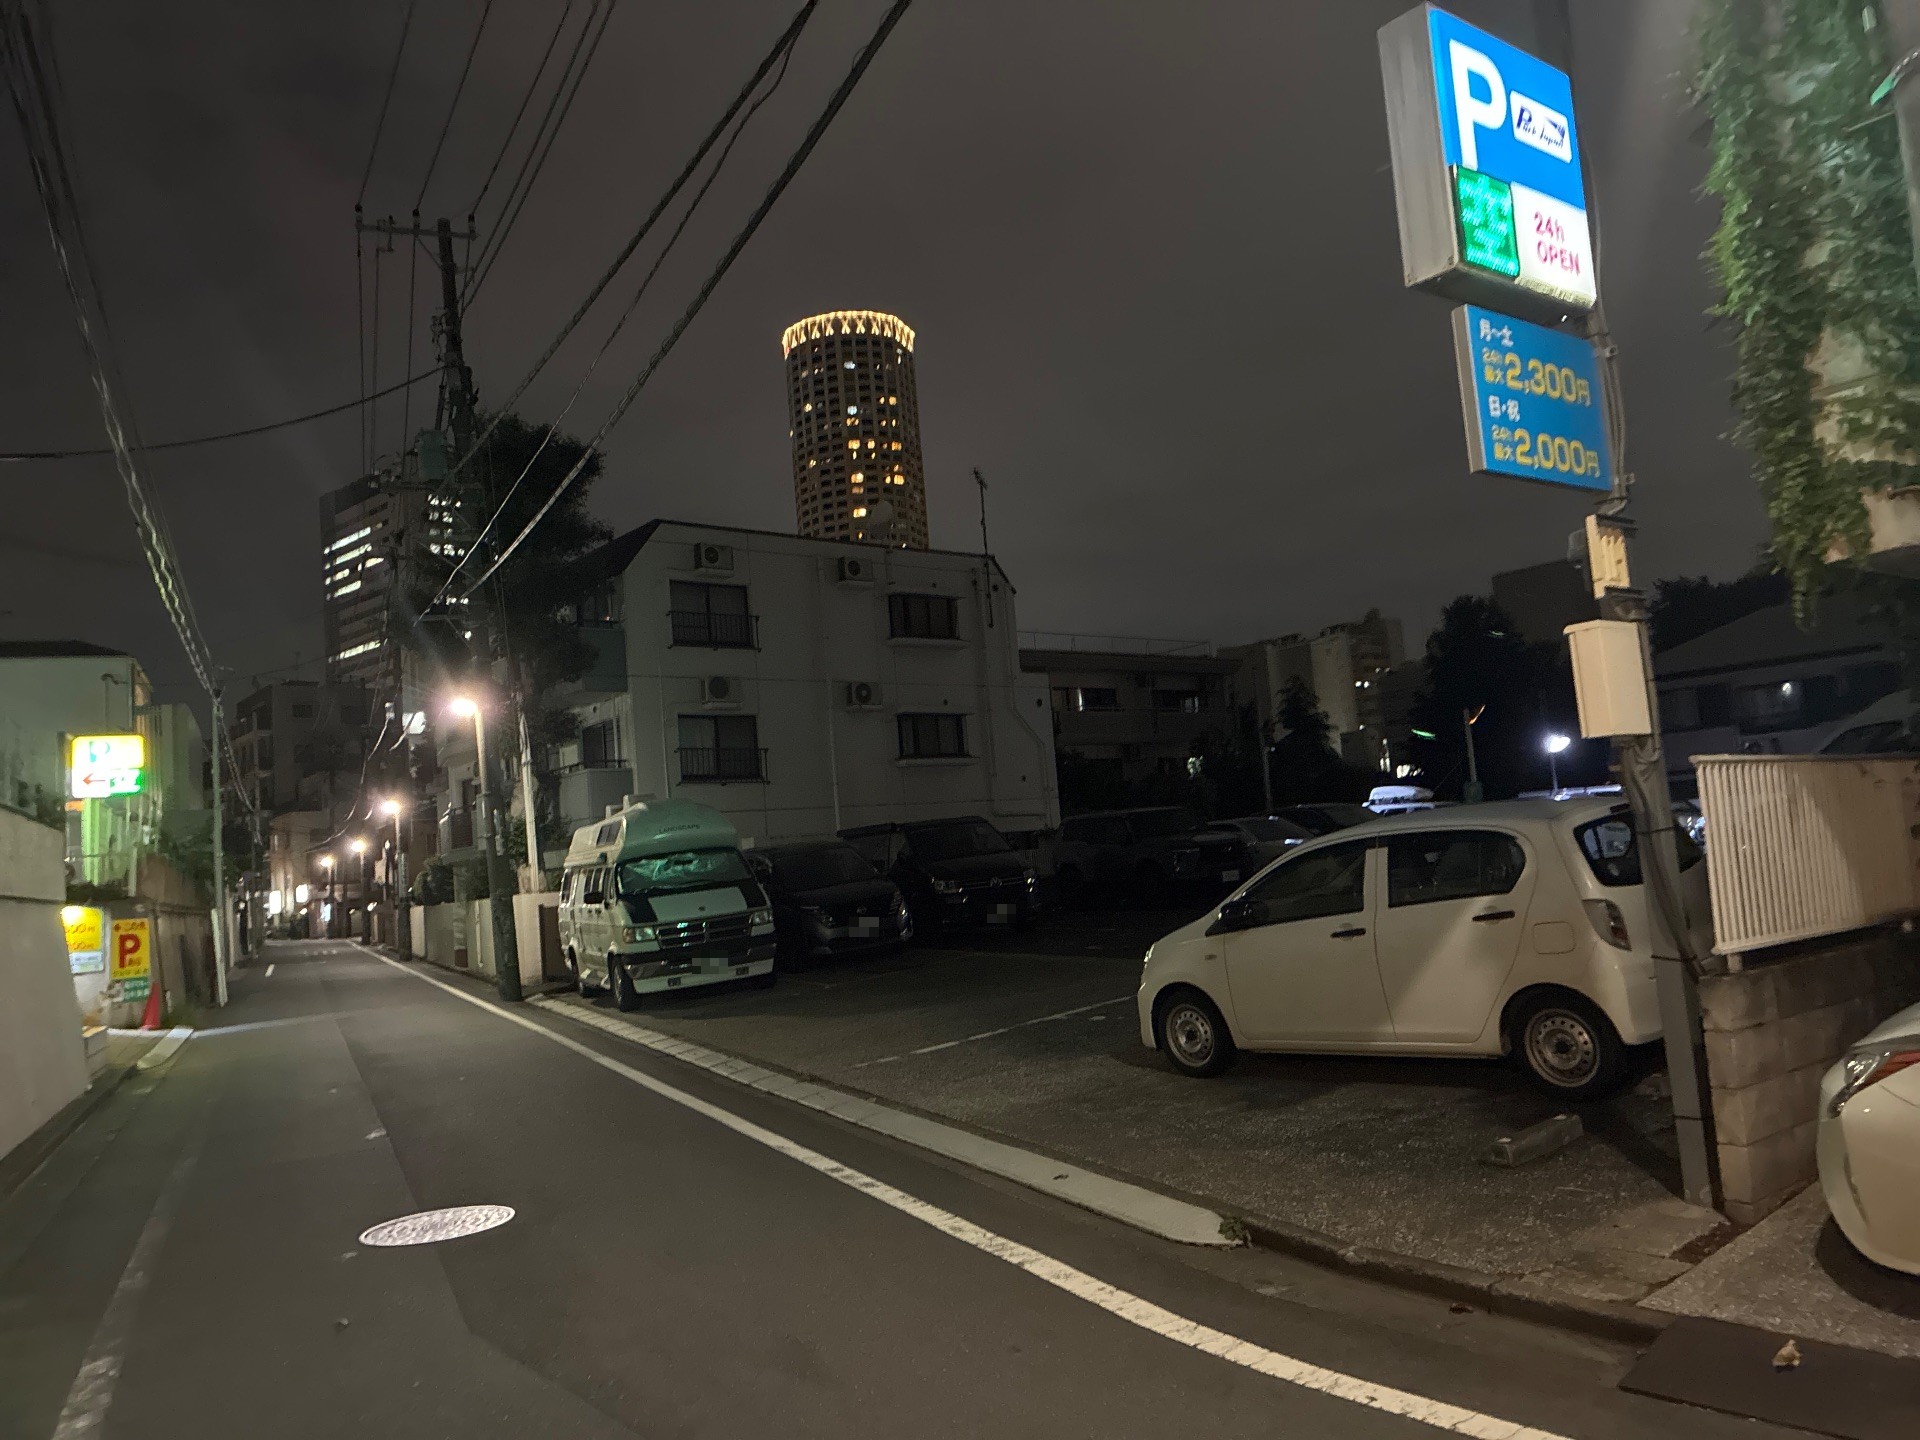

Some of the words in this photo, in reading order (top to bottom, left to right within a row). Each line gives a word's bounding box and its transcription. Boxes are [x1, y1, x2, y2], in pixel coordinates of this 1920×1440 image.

[1449, 38, 1507, 172] P
[1534, 211, 1566, 242] 24h
[1536, 240, 1581, 276] OPEN
[1504, 352, 1592, 407] 2,300円
[1513, 428, 1601, 478] 2,000円
[119, 933, 142, 969] P
